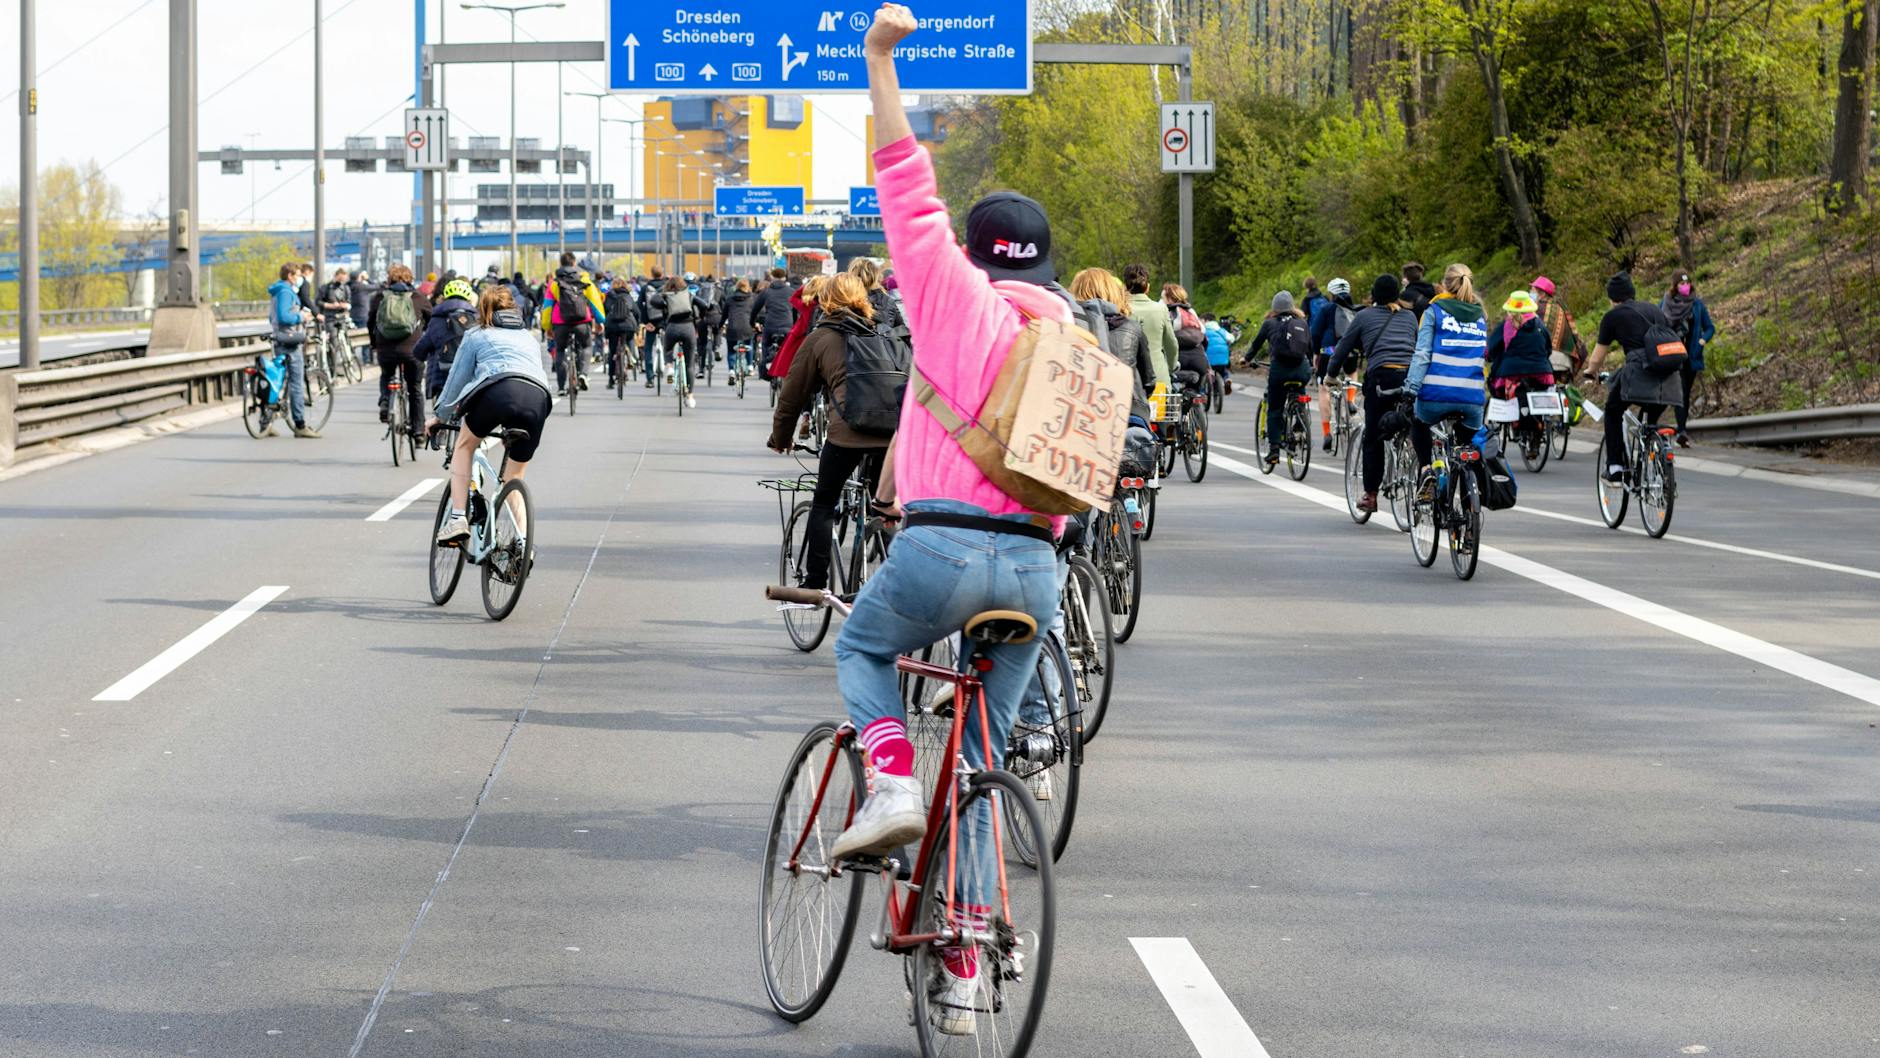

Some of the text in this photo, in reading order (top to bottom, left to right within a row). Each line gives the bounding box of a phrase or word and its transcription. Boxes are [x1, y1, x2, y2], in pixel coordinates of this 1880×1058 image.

[675, 9, 741, 25] Dresden
[853, 16, 866, 27] 14
[918, 14, 996, 33] argendorf
[662, 28, 755, 47] Schöneberg
[963, 43, 1016, 59] Straße
[660, 66, 681, 79] 100
[737, 66, 757, 79] 100
[817, 70, 849, 82] 150 m
[993, 239, 1038, 258] FILA
[1071, 343, 1108, 383] ET
[1047, 359, 1115, 421] PUIS
[1043, 397, 1097, 439] JE
[1021, 434, 1115, 501] FUME
